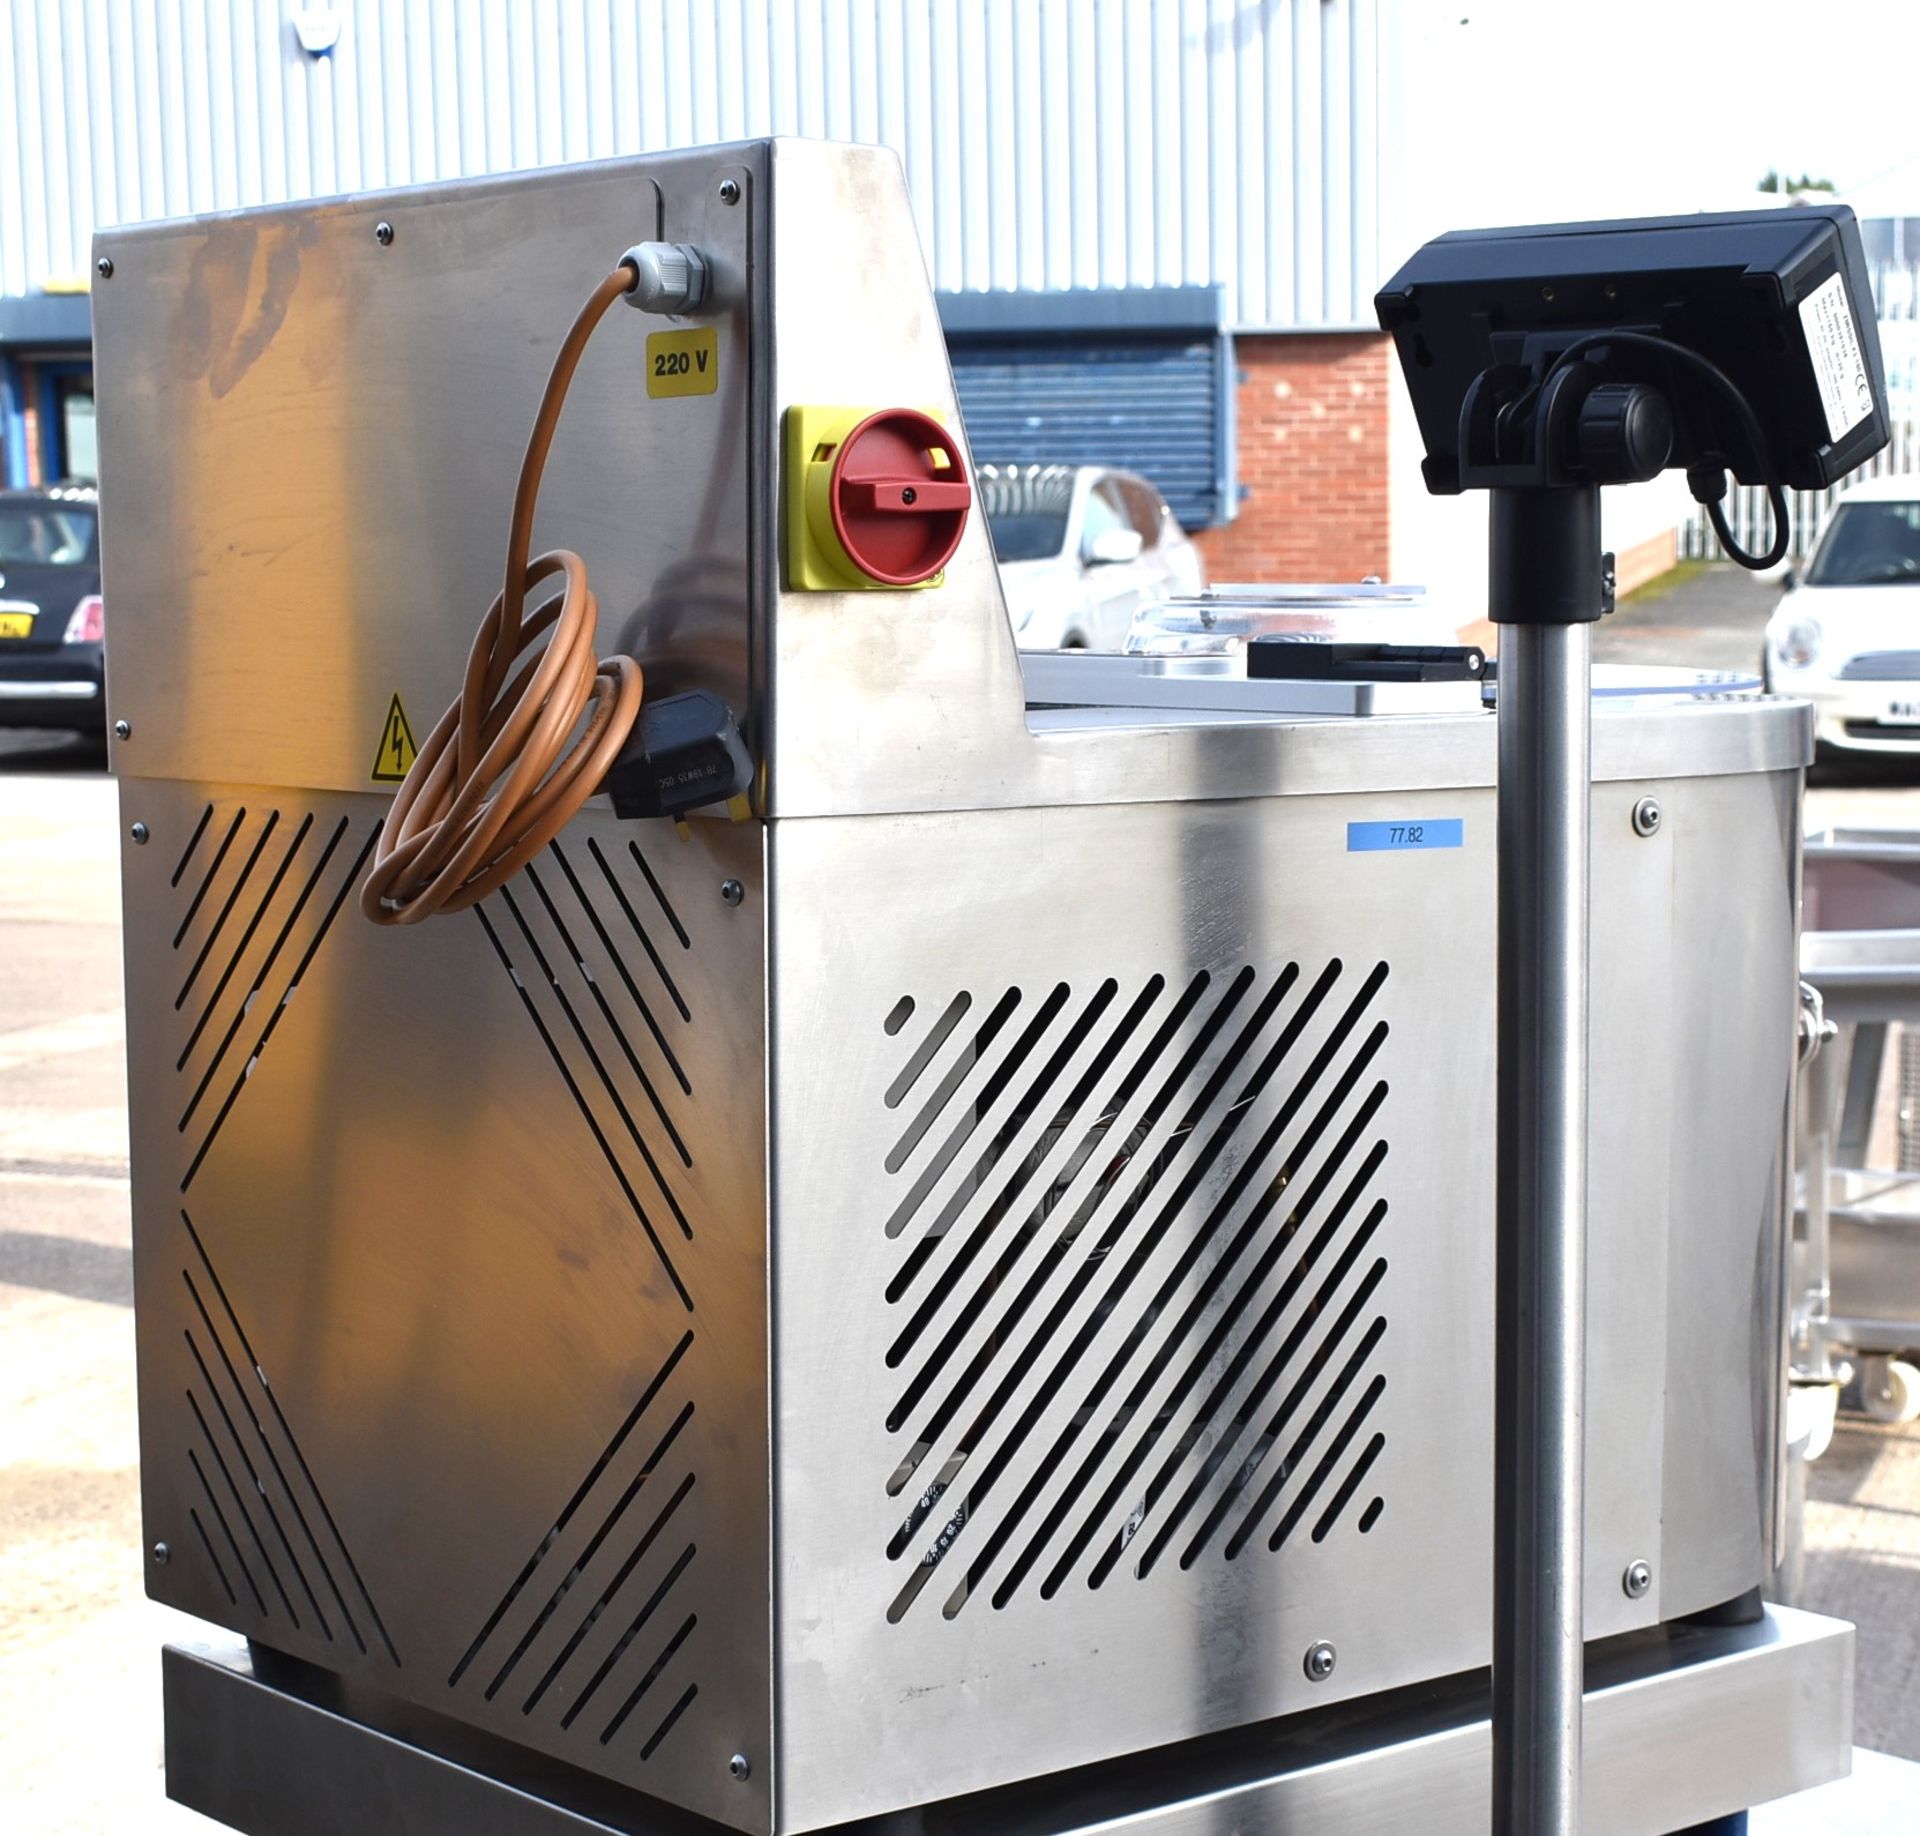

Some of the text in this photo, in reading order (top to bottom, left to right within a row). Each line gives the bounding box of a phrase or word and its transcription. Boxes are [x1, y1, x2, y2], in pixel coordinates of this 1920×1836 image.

[655, 349, 708, 376] 220 V
[1389, 826, 1424, 843] 77.82
